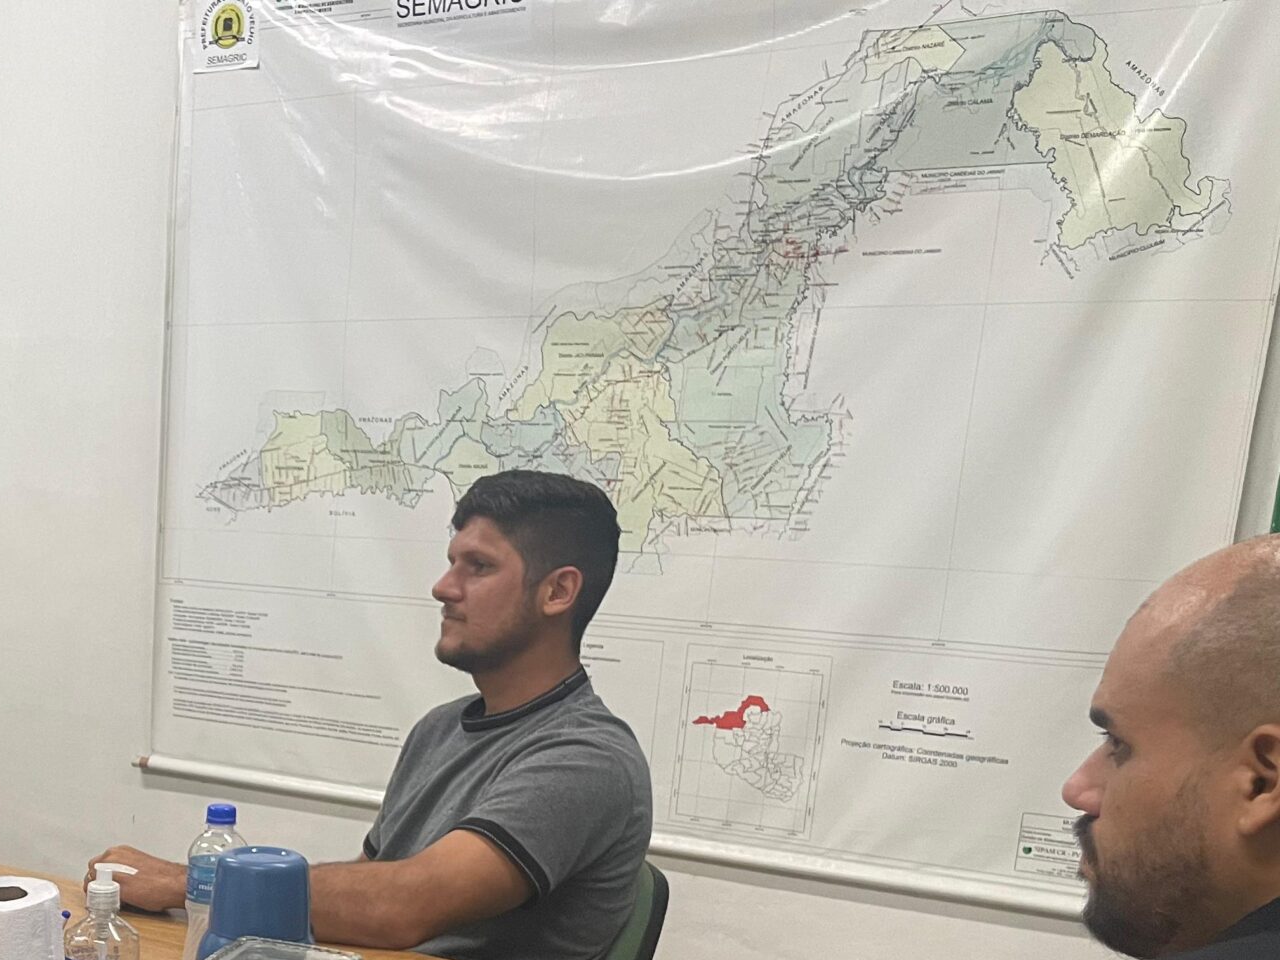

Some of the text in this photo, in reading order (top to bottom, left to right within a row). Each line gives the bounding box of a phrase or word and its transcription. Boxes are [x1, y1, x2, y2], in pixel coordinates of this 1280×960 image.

[206, 53, 248, 65] SEMAGRIC
[892, 680, 924, 691] Escala:
[897, 711, 925, 722] Escala
